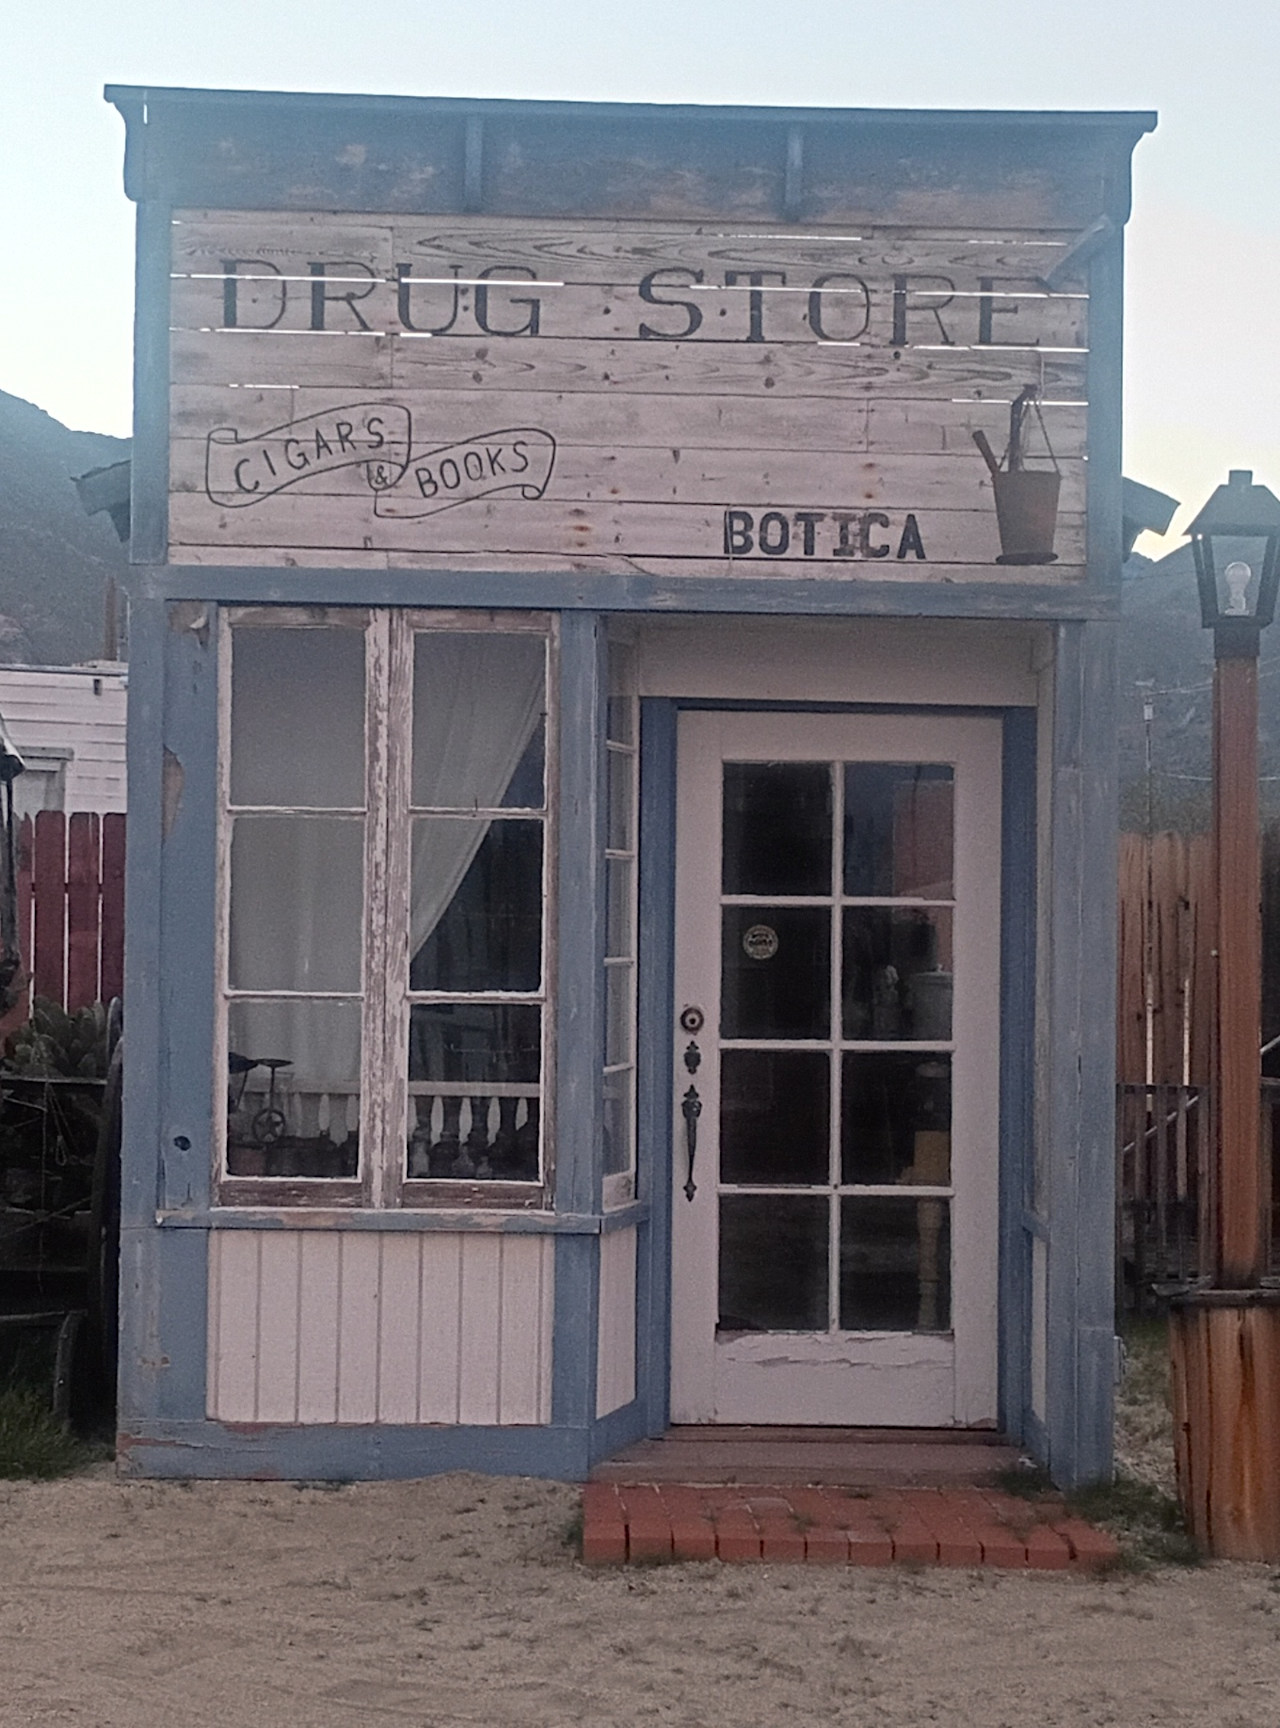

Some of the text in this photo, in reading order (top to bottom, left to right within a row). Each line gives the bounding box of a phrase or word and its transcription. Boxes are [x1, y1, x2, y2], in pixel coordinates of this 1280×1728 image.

[220, 259, 1040, 346] DRUG STORE
[235, 417, 529, 498] CIGARS & BOOKS
[724, 510, 926, 560] BOTICA
